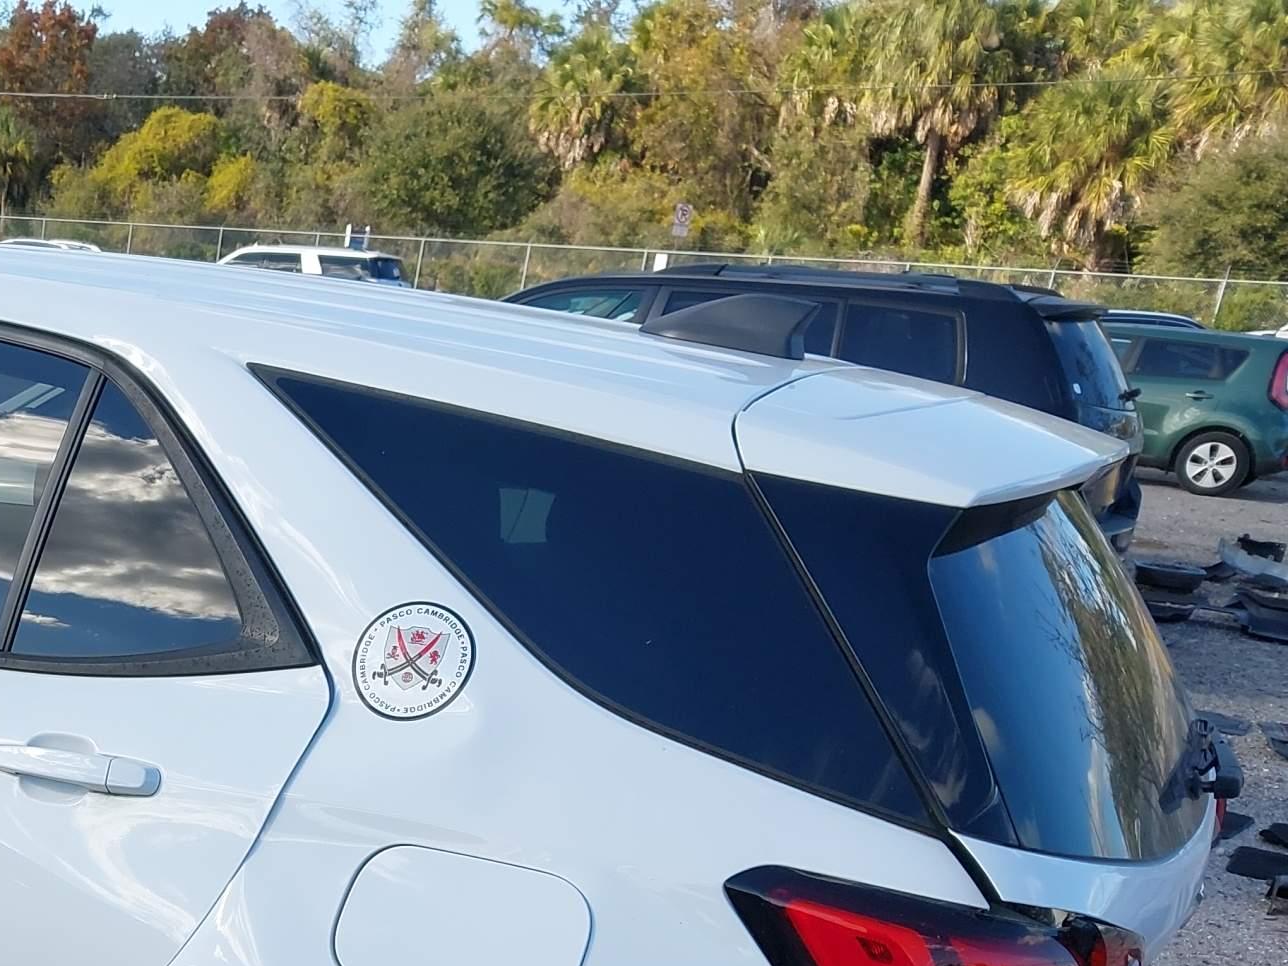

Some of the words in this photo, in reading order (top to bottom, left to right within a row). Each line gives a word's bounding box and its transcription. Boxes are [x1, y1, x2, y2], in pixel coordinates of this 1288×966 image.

[379, 608, 413, 628] PASCO
[416, 607, 465, 641] CAMBRIDGE
[359, 634, 376, 691] CAMBRIDGE
[455, 646, 468, 678] PASCO
[369, 692, 397, 713] PASCO
[403, 680, 457, 714] CAMBRIDGE
